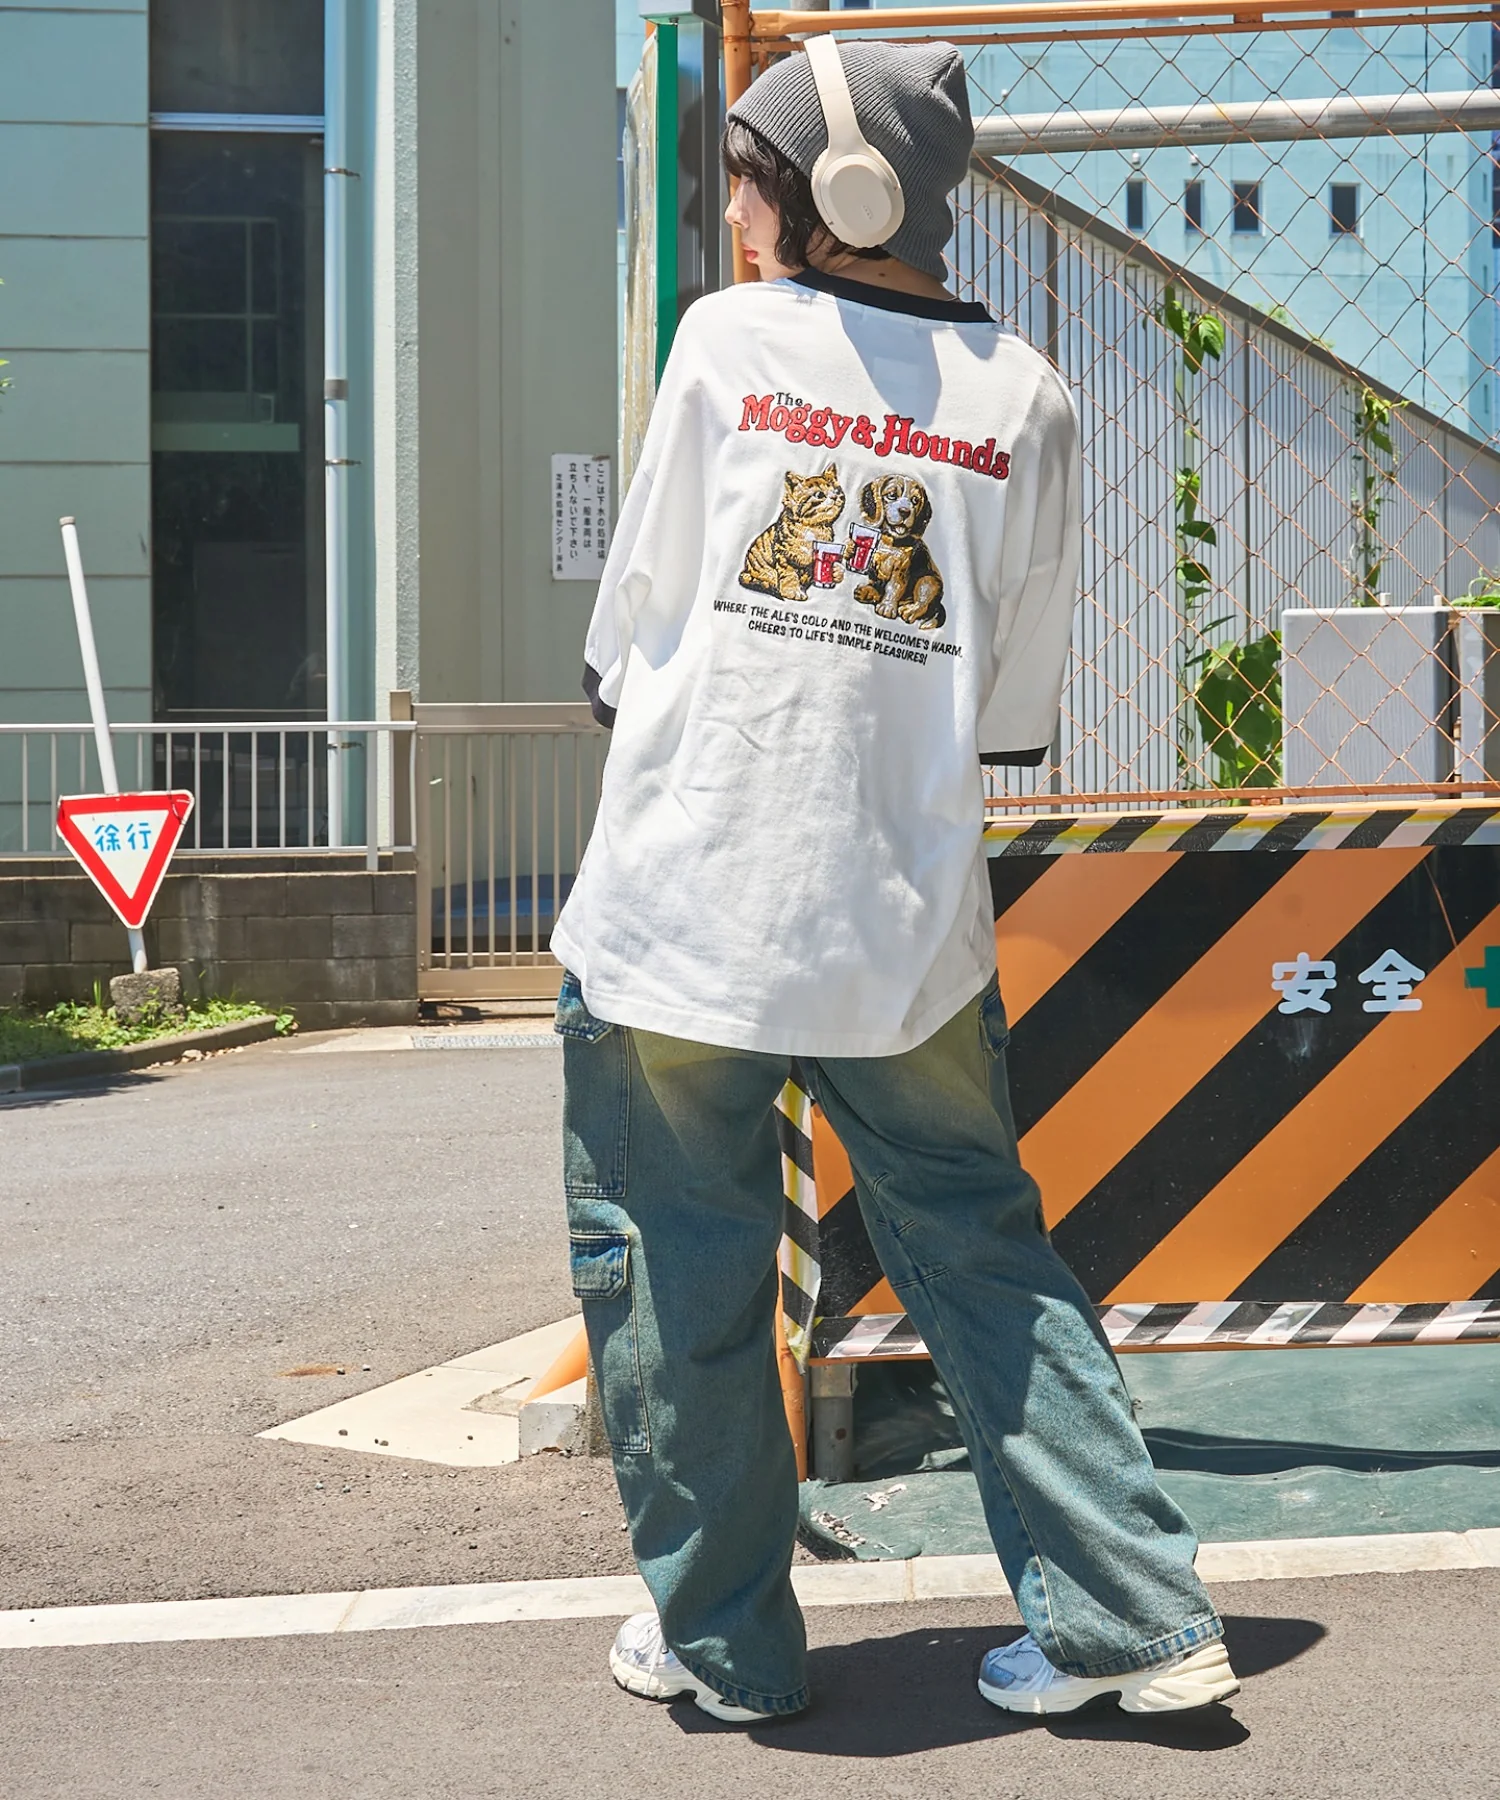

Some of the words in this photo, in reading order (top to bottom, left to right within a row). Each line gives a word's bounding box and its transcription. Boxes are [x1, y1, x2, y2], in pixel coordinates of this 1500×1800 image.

[776, 392, 803, 406] The
[738, 394, 853, 449] Moggy
[874, 414, 1011, 480] Hounds
[713, 600, 747, 614] WHERE
[750, 606, 769, 619] THE
[771, 610, 799, 624] ALE'S
[801, 615, 828, 627] COLD
[830, 619, 851, 631] AND
[854, 623, 872, 636] THE
[874, 627, 930, 650] WELCOME'S
[931, 641, 963, 658] WARM.
[748, 620, 787, 636] CHEERS
[789, 627, 803, 639] TO
[805, 629, 834, 643] LIFE'S
[837, 634, 872, 651] SIMPLE
[873, 642, 928, 666] PLEASURES!
[94, 822, 152, 852] 徐行
[1271, 948, 1426, 1015] 安全
